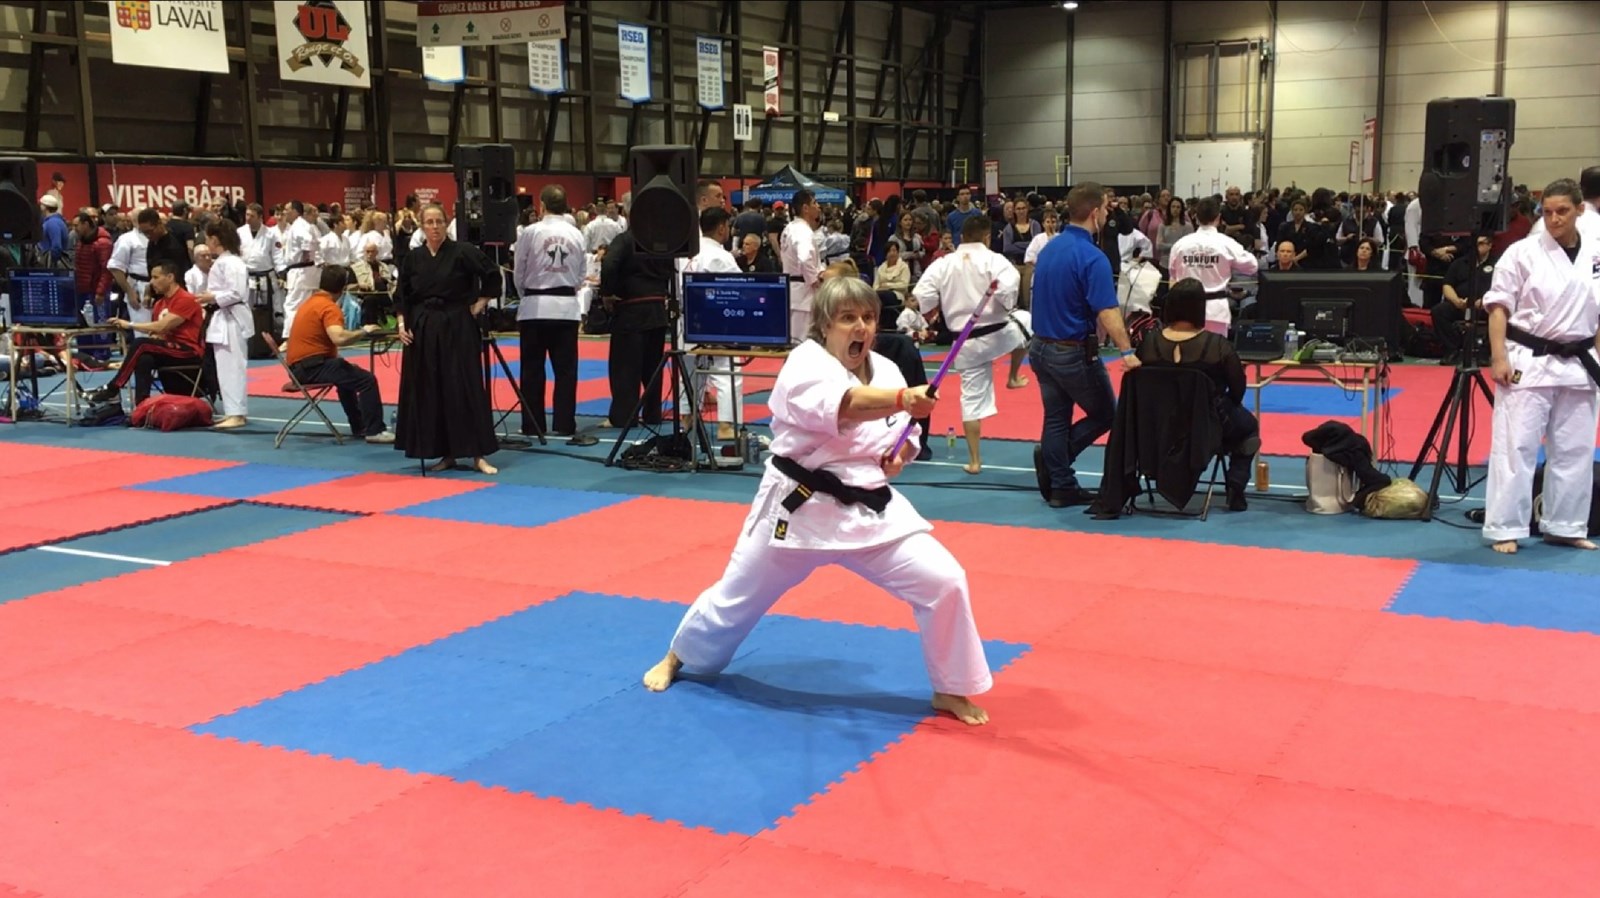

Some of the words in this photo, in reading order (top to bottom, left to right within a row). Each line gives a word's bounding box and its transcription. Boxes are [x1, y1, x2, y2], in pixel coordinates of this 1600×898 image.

[467, 1, 487, 12] DANS
[488, 1, 498, 11] LE
[157, 4, 219, 31] LAVAL
[297, 5, 349, 40] UL
[621, 29, 645, 43] RSEQ
[107, 184, 178, 208] VIENS
[1183, 255, 1219, 265] SUNFUKI
